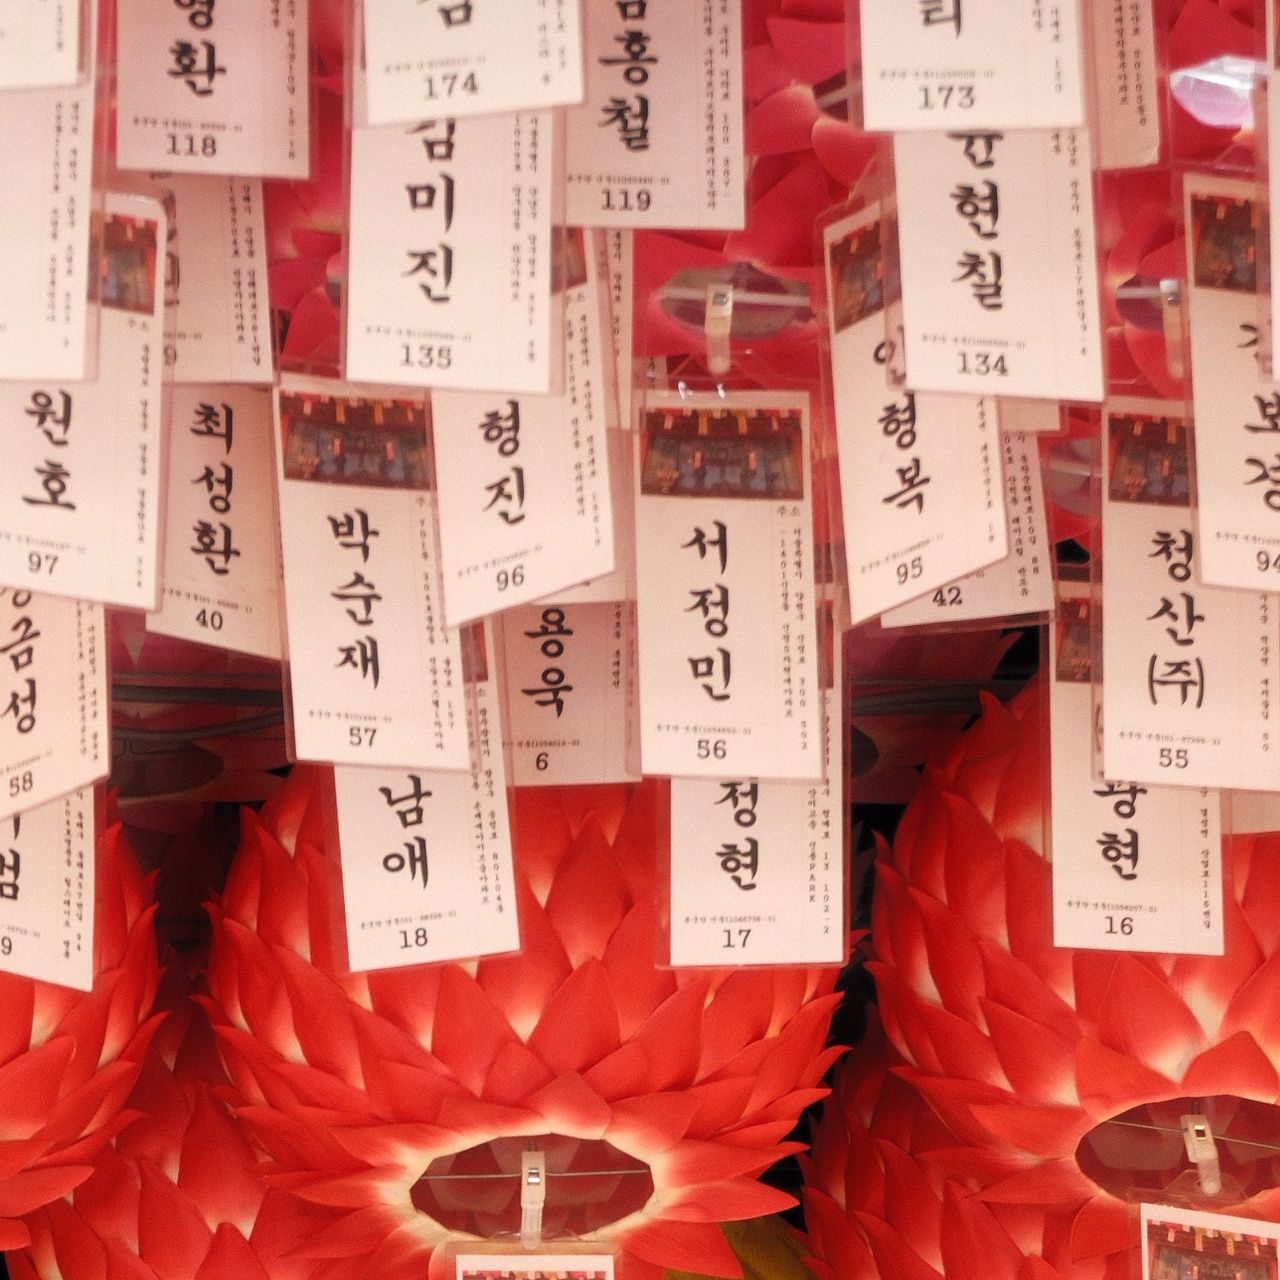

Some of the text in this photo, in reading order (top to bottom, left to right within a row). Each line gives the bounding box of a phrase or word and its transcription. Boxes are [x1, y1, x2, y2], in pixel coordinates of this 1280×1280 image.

[423, 72, 479, 99] 174
[918, 85, 976, 110] 173
[166, 133, 217, 157] 118
[600, 188, 652, 211] 119
[399, 344, 453, 371] 135
[956, 352, 1010, 378] 134
[190, 401, 240, 576] 최성환
[26, 550, 59, 577] 97
[896, 558, 924, 585] 95
[496, 564, 527, 591] 96
[327, 508, 383, 690] 박순재
[932, 587, 964, 607] 42
[195, 606, 224, 632] 40
[681, 519, 731, 702] 서정민
[348, 725, 378, 749] 57
[534, 751, 550, 772] 6
[696, 739, 728, 762] 56
[1158, 746, 1191, 770] 55
[7, 773, 35, 798] 58
[398, 926, 429, 949] 18
[722, 928, 752, 949] 17
[1103, 917, 1135, 937] 16
